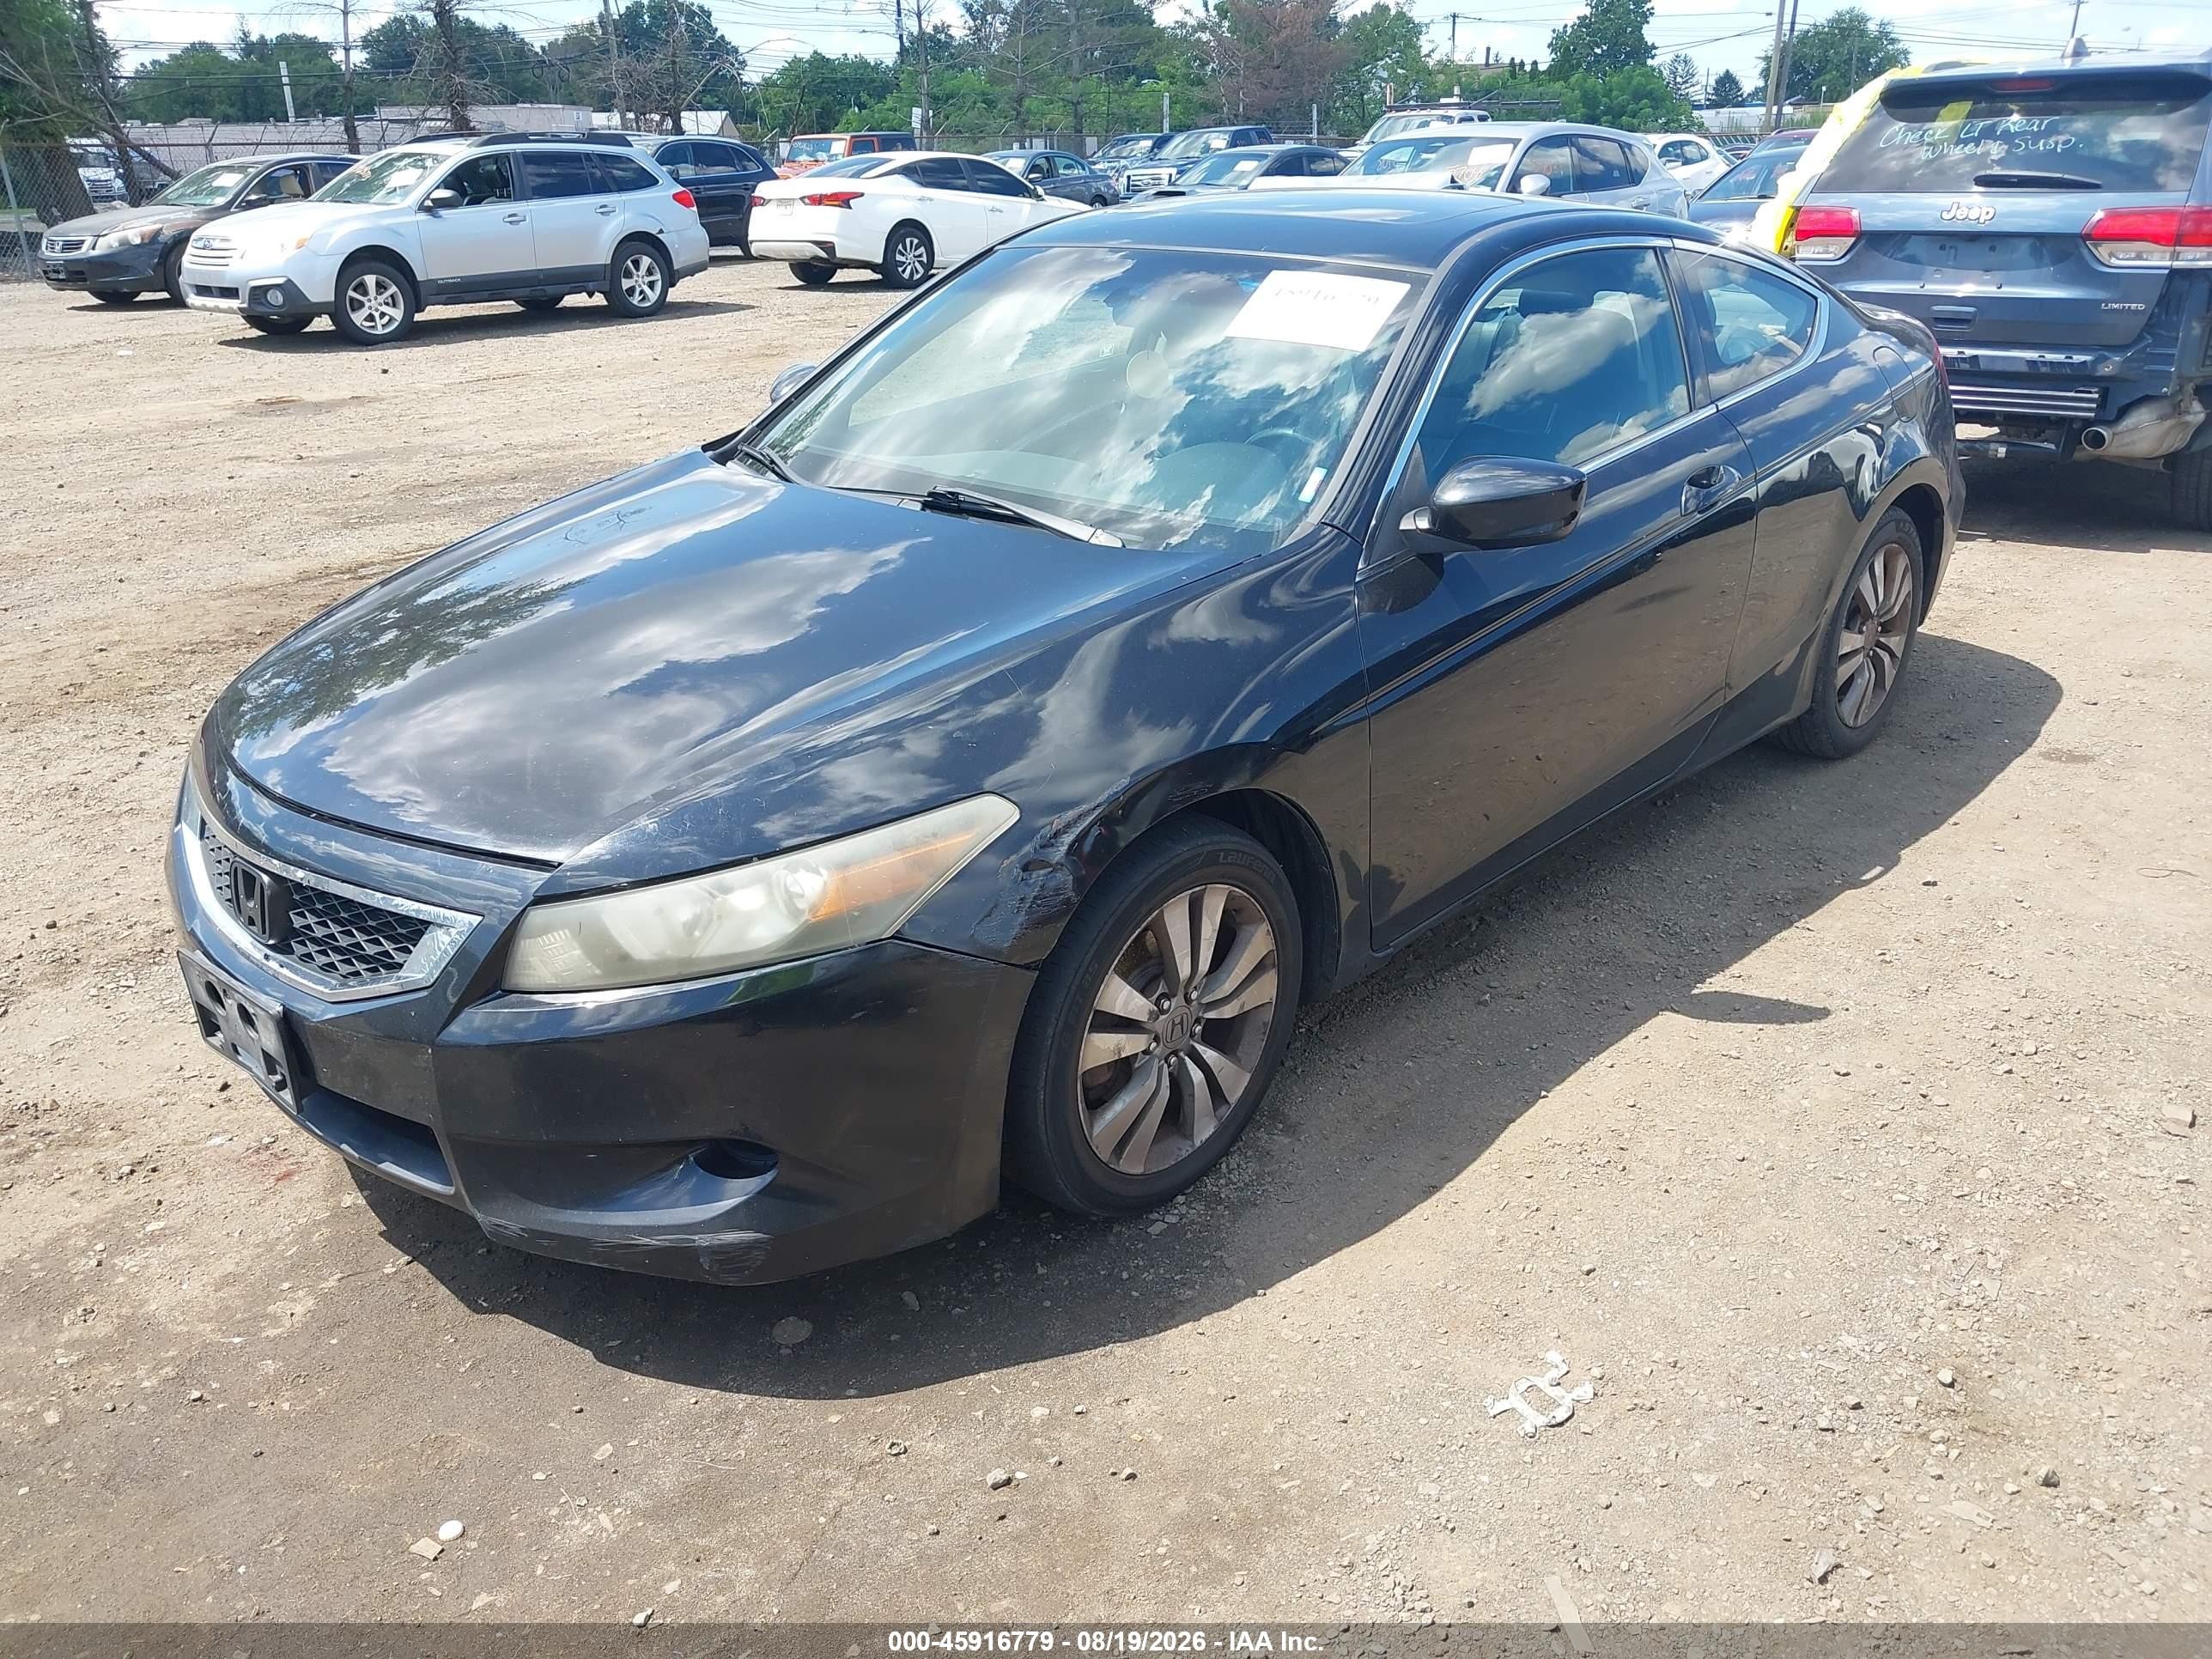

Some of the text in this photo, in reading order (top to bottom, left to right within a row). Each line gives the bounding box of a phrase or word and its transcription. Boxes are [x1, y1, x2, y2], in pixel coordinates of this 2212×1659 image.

[1880, 117, 2060, 148] Check LT Rear
[1941, 203, 1996, 224] Jeep
